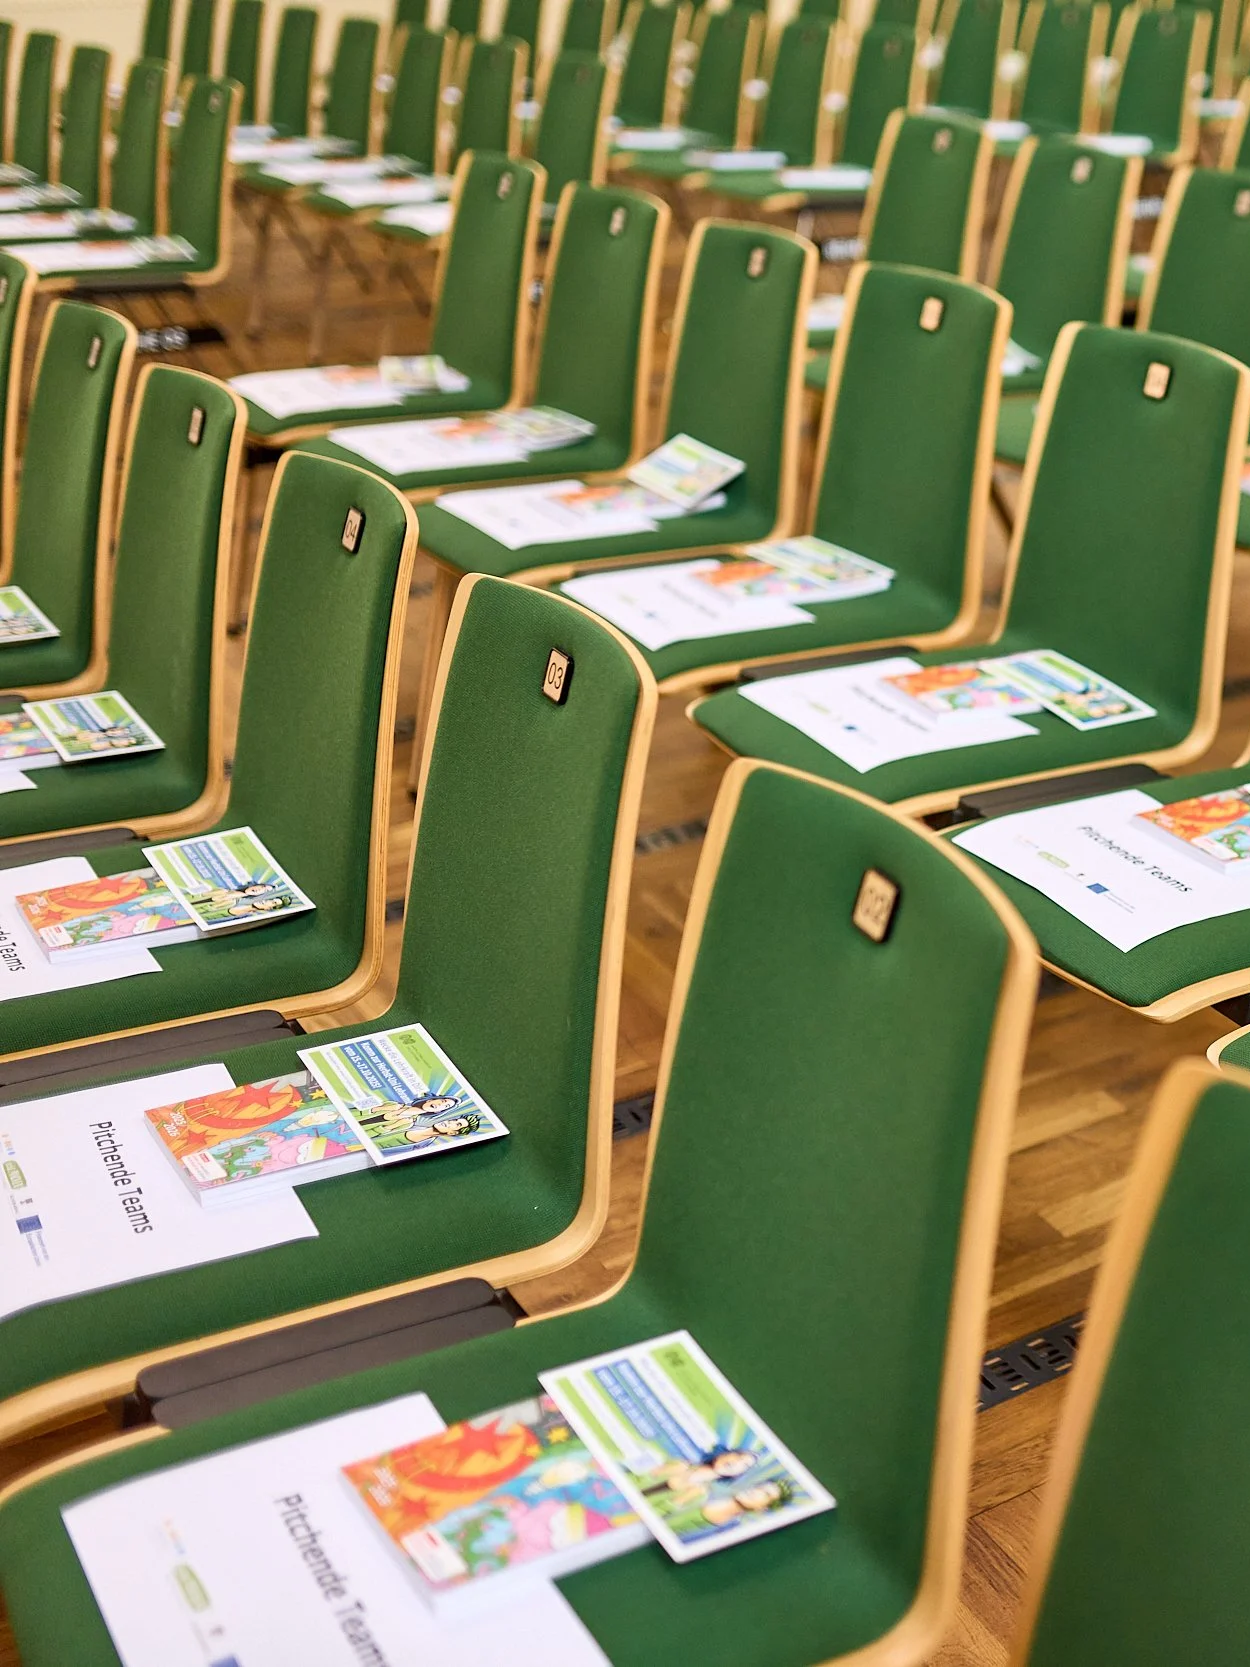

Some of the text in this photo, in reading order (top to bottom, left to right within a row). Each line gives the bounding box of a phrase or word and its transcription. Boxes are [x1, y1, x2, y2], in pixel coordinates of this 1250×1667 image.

[346, 520, 357, 541] 04
[548, 662, 563, 689] 03
[1144, 866, 1192, 892] Teams
[0, 942, 26, 971] Teams
[89, 1121, 153, 1234] Pitchende Teams
[274, 1493, 392, 1667] Pitchende Team
